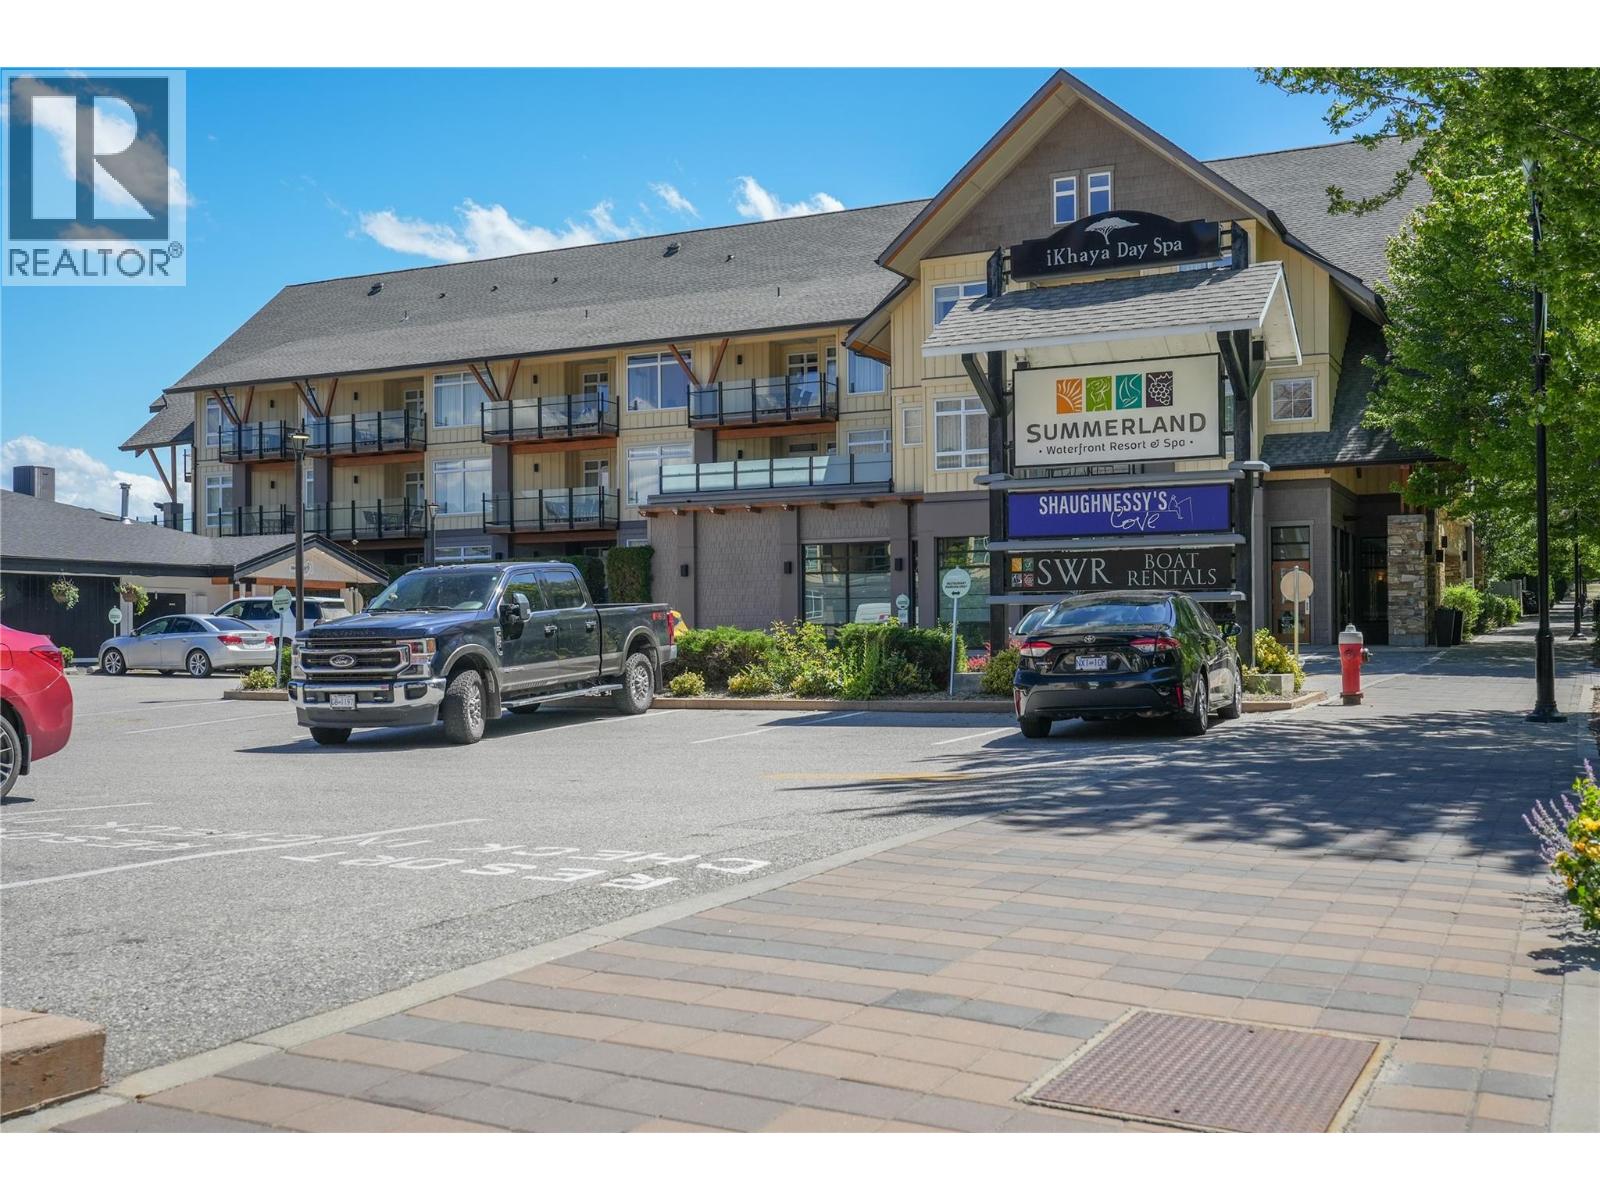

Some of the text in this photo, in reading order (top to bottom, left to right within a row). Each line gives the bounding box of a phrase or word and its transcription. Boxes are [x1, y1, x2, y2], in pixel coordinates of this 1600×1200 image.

[1046, 236, 1183, 267] iKhaya Day Spa
[1026, 412, 1207, 444] SUMMERLAND
[1046, 442, 1106, 456] Waterfront
[1109, 439, 1147, 452] Resort
[1163, 437, 1186, 449] Spa
[1038, 490, 1169, 516] SHAUGHNESSY'S
[1110, 505, 1161, 532] Cove
[1037, 557, 1113, 586] SWR
[1144, 552, 1200, 571] BOAT
[1127, 568, 1218, 587] RENTALS
[279, 851, 681, 891] RESORT
[448, 843, 773, 875] CHECK
